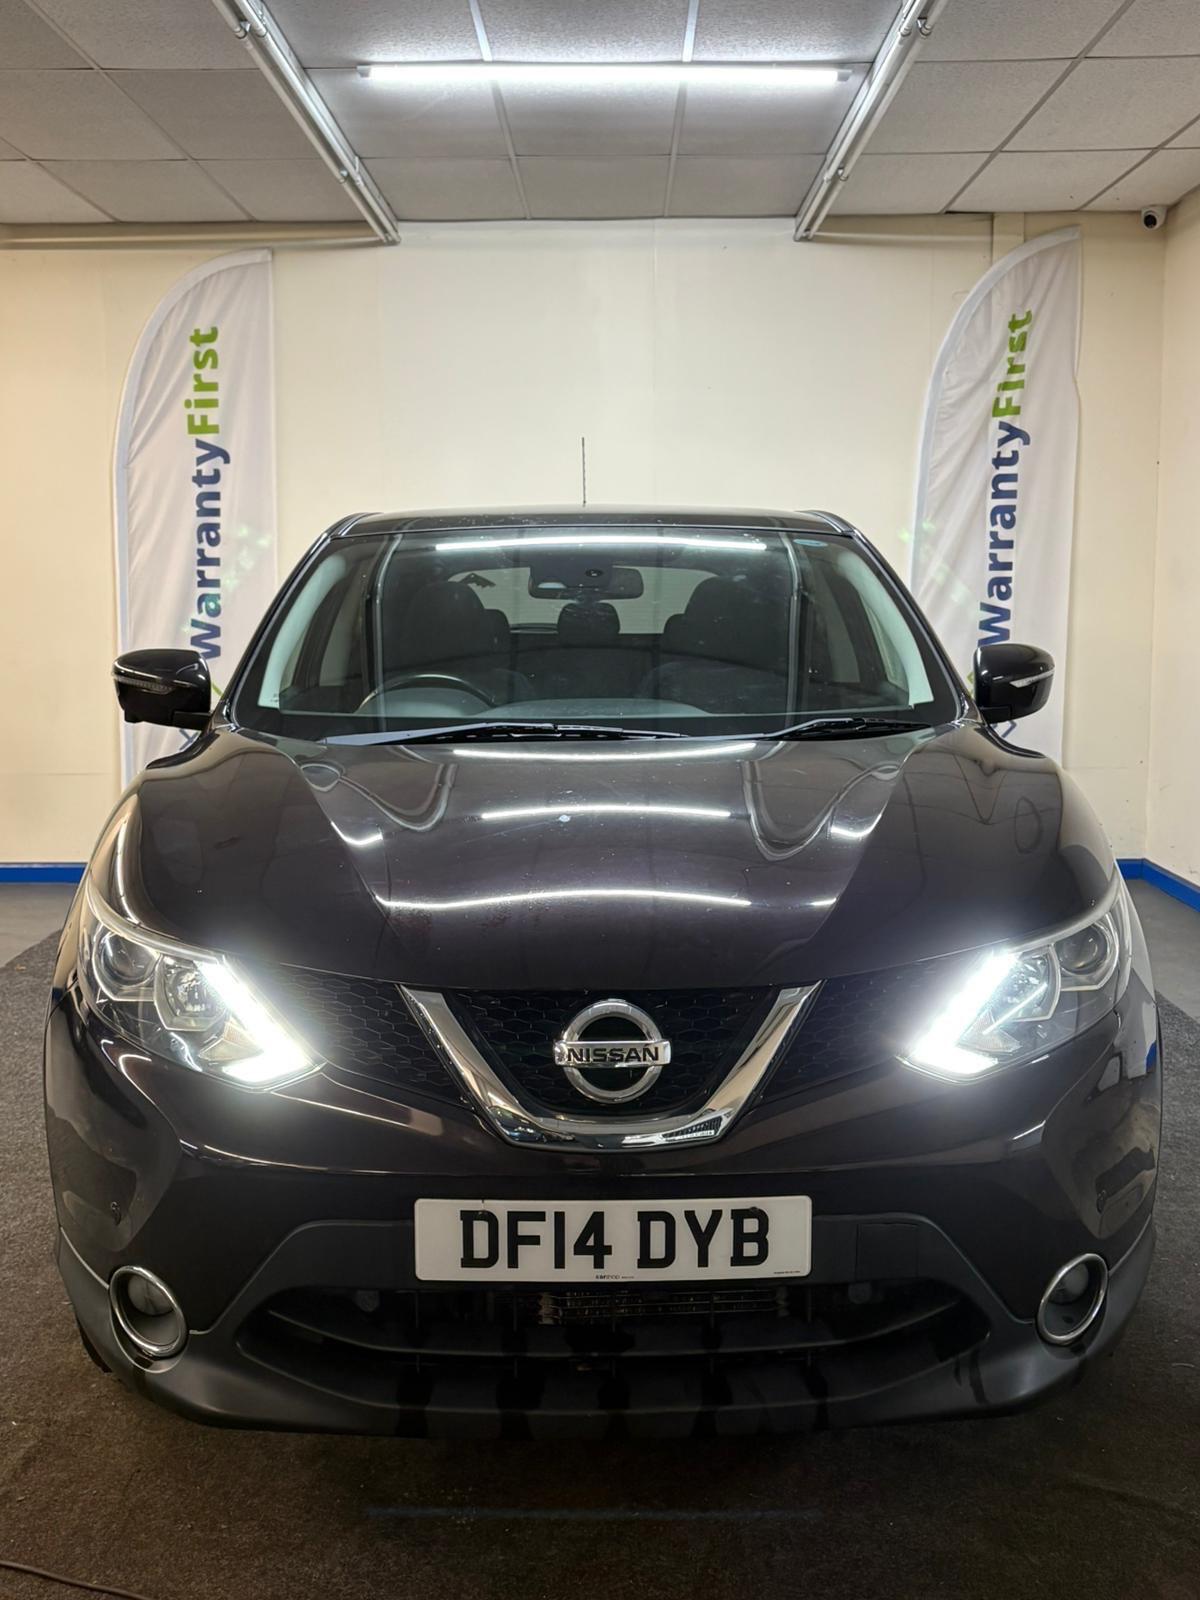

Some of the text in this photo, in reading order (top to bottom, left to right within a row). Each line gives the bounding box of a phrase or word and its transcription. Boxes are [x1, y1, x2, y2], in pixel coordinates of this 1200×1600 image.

[184, 326, 231, 660] WarrantyFirst
[978, 309, 1032, 647] WarrantyFirst
[567, 1047, 659, 1063] NISSAN
[459, 1206, 770, 1270] DF14 DYB
